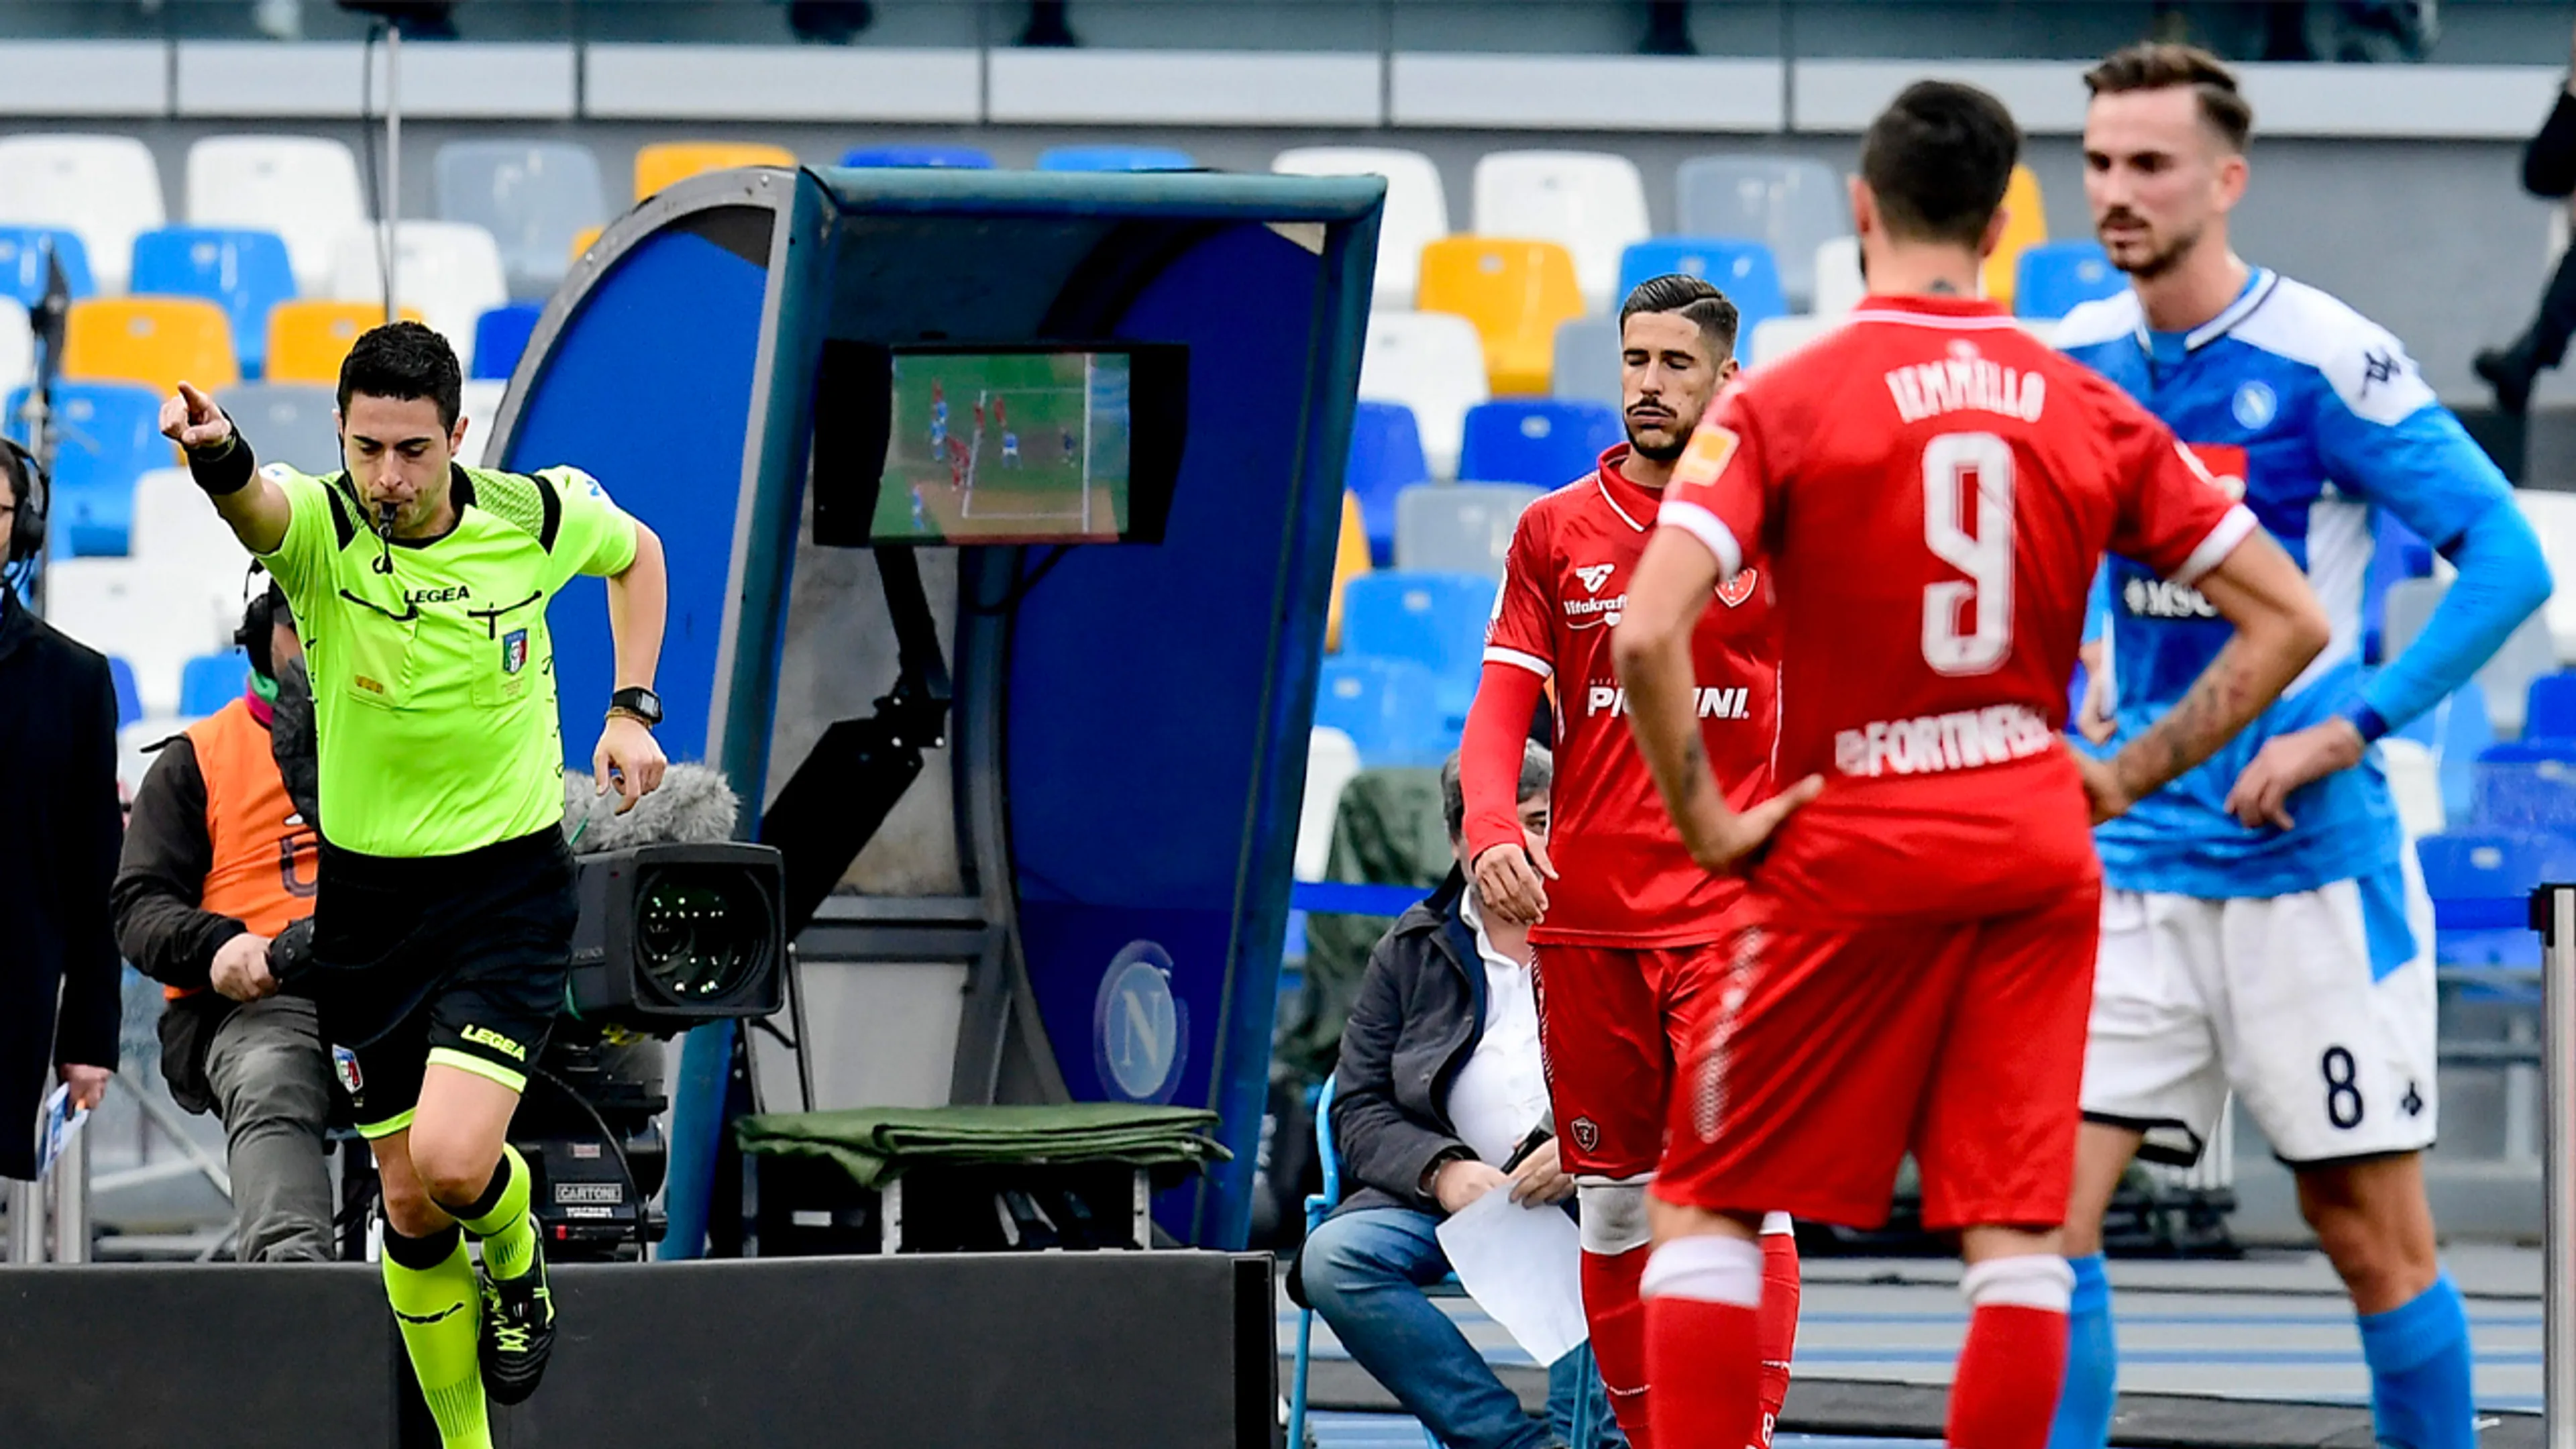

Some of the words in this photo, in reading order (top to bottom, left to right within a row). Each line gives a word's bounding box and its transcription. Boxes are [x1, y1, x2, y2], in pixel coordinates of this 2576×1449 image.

[1884, 360, 2046, 424] IEMMELLO
[1921, 431, 2017, 678] 9
[404, 585, 470, 603] LEGEA
[460, 1024, 526, 1062] LEGEA
[2322, 1046, 2364, 1129] 8
